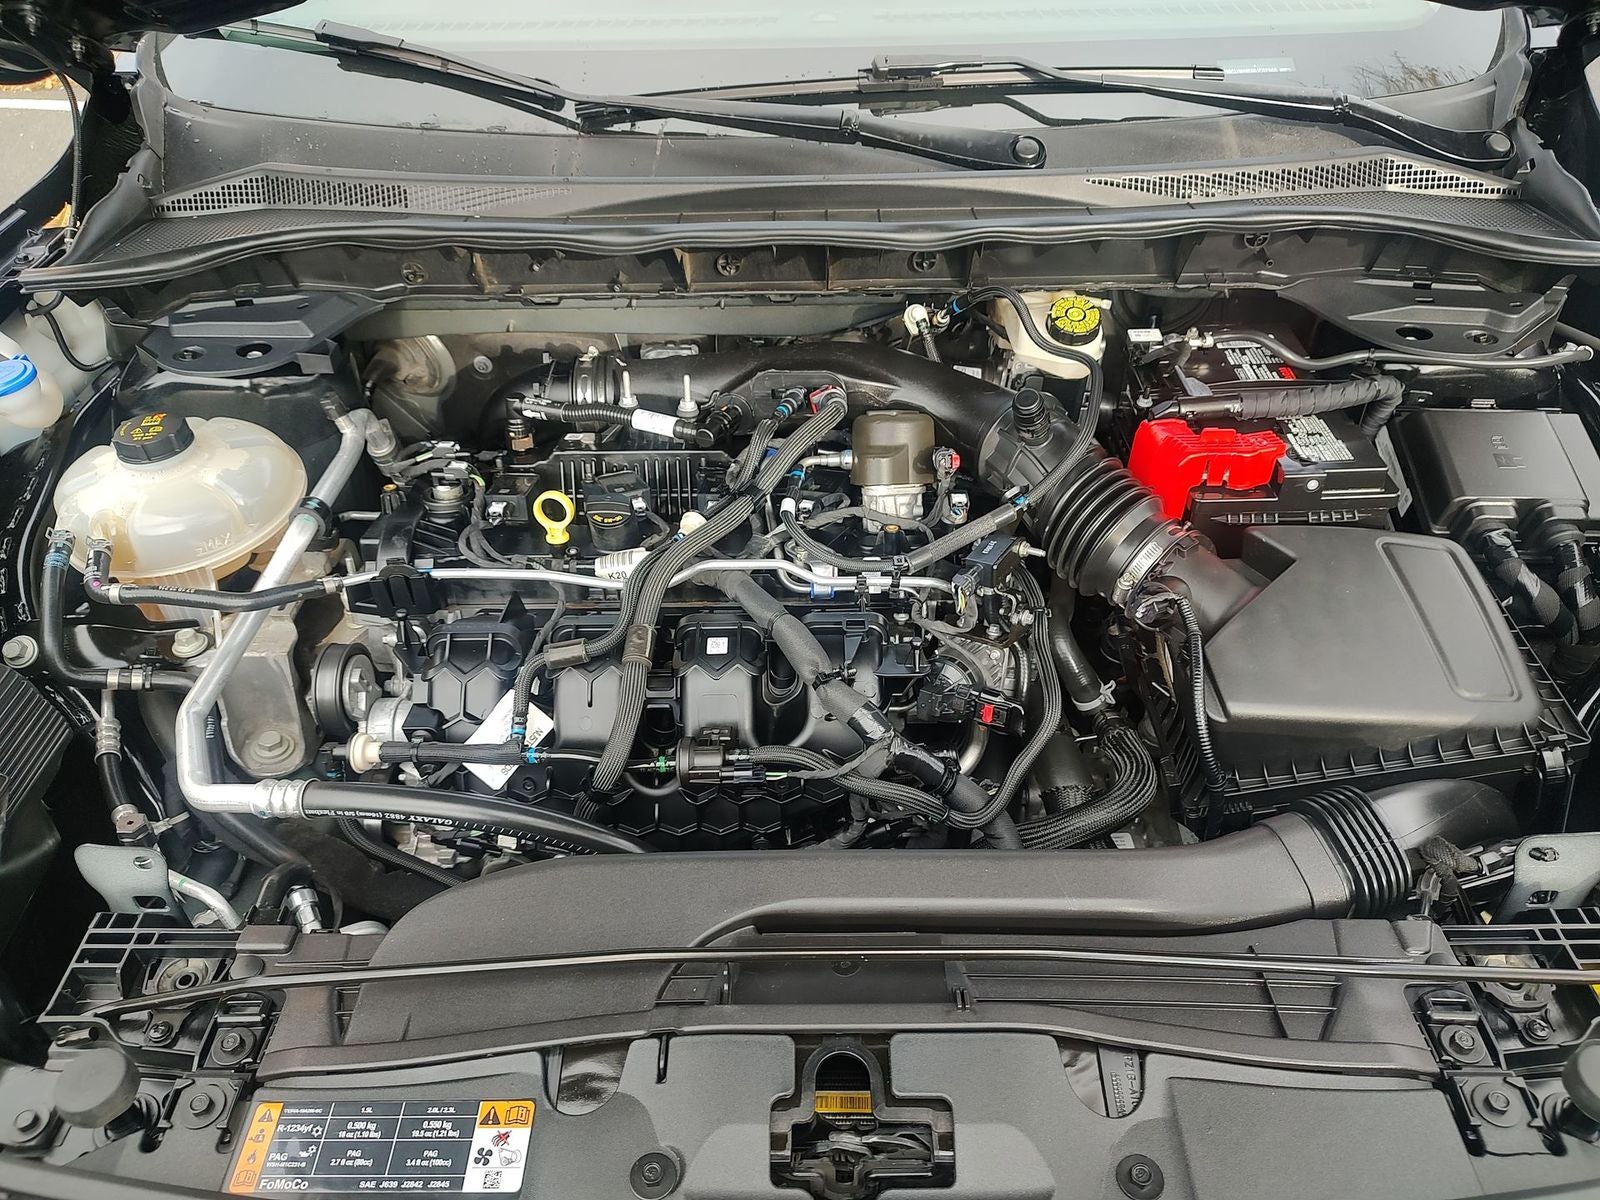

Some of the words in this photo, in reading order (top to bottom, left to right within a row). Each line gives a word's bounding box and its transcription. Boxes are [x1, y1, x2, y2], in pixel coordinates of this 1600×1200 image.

[384, 812, 407, 821] 4882
[408, 814, 453, 826] GALAXY
[276, 1124, 314, 1134] R-1234yf
[347, 1121, 366, 1130] 0.500
[367, 1121, 377, 1131] kg
[422, 1120, 442, 1129] 0.550
[442, 1120, 453, 1130] kg
[268, 1152, 289, 1161] PAG
[346, 1149, 362, 1158] PAG
[423, 1149, 439, 1158] PAG
[258, 1178, 309, 1190] FoMoCo
[358, 1180, 377, 1189] SAE
[379, 1180, 398, 1189] J639
[400, 1180, 424, 1189] J2842
[427, 1180, 451, 1189] J2845
